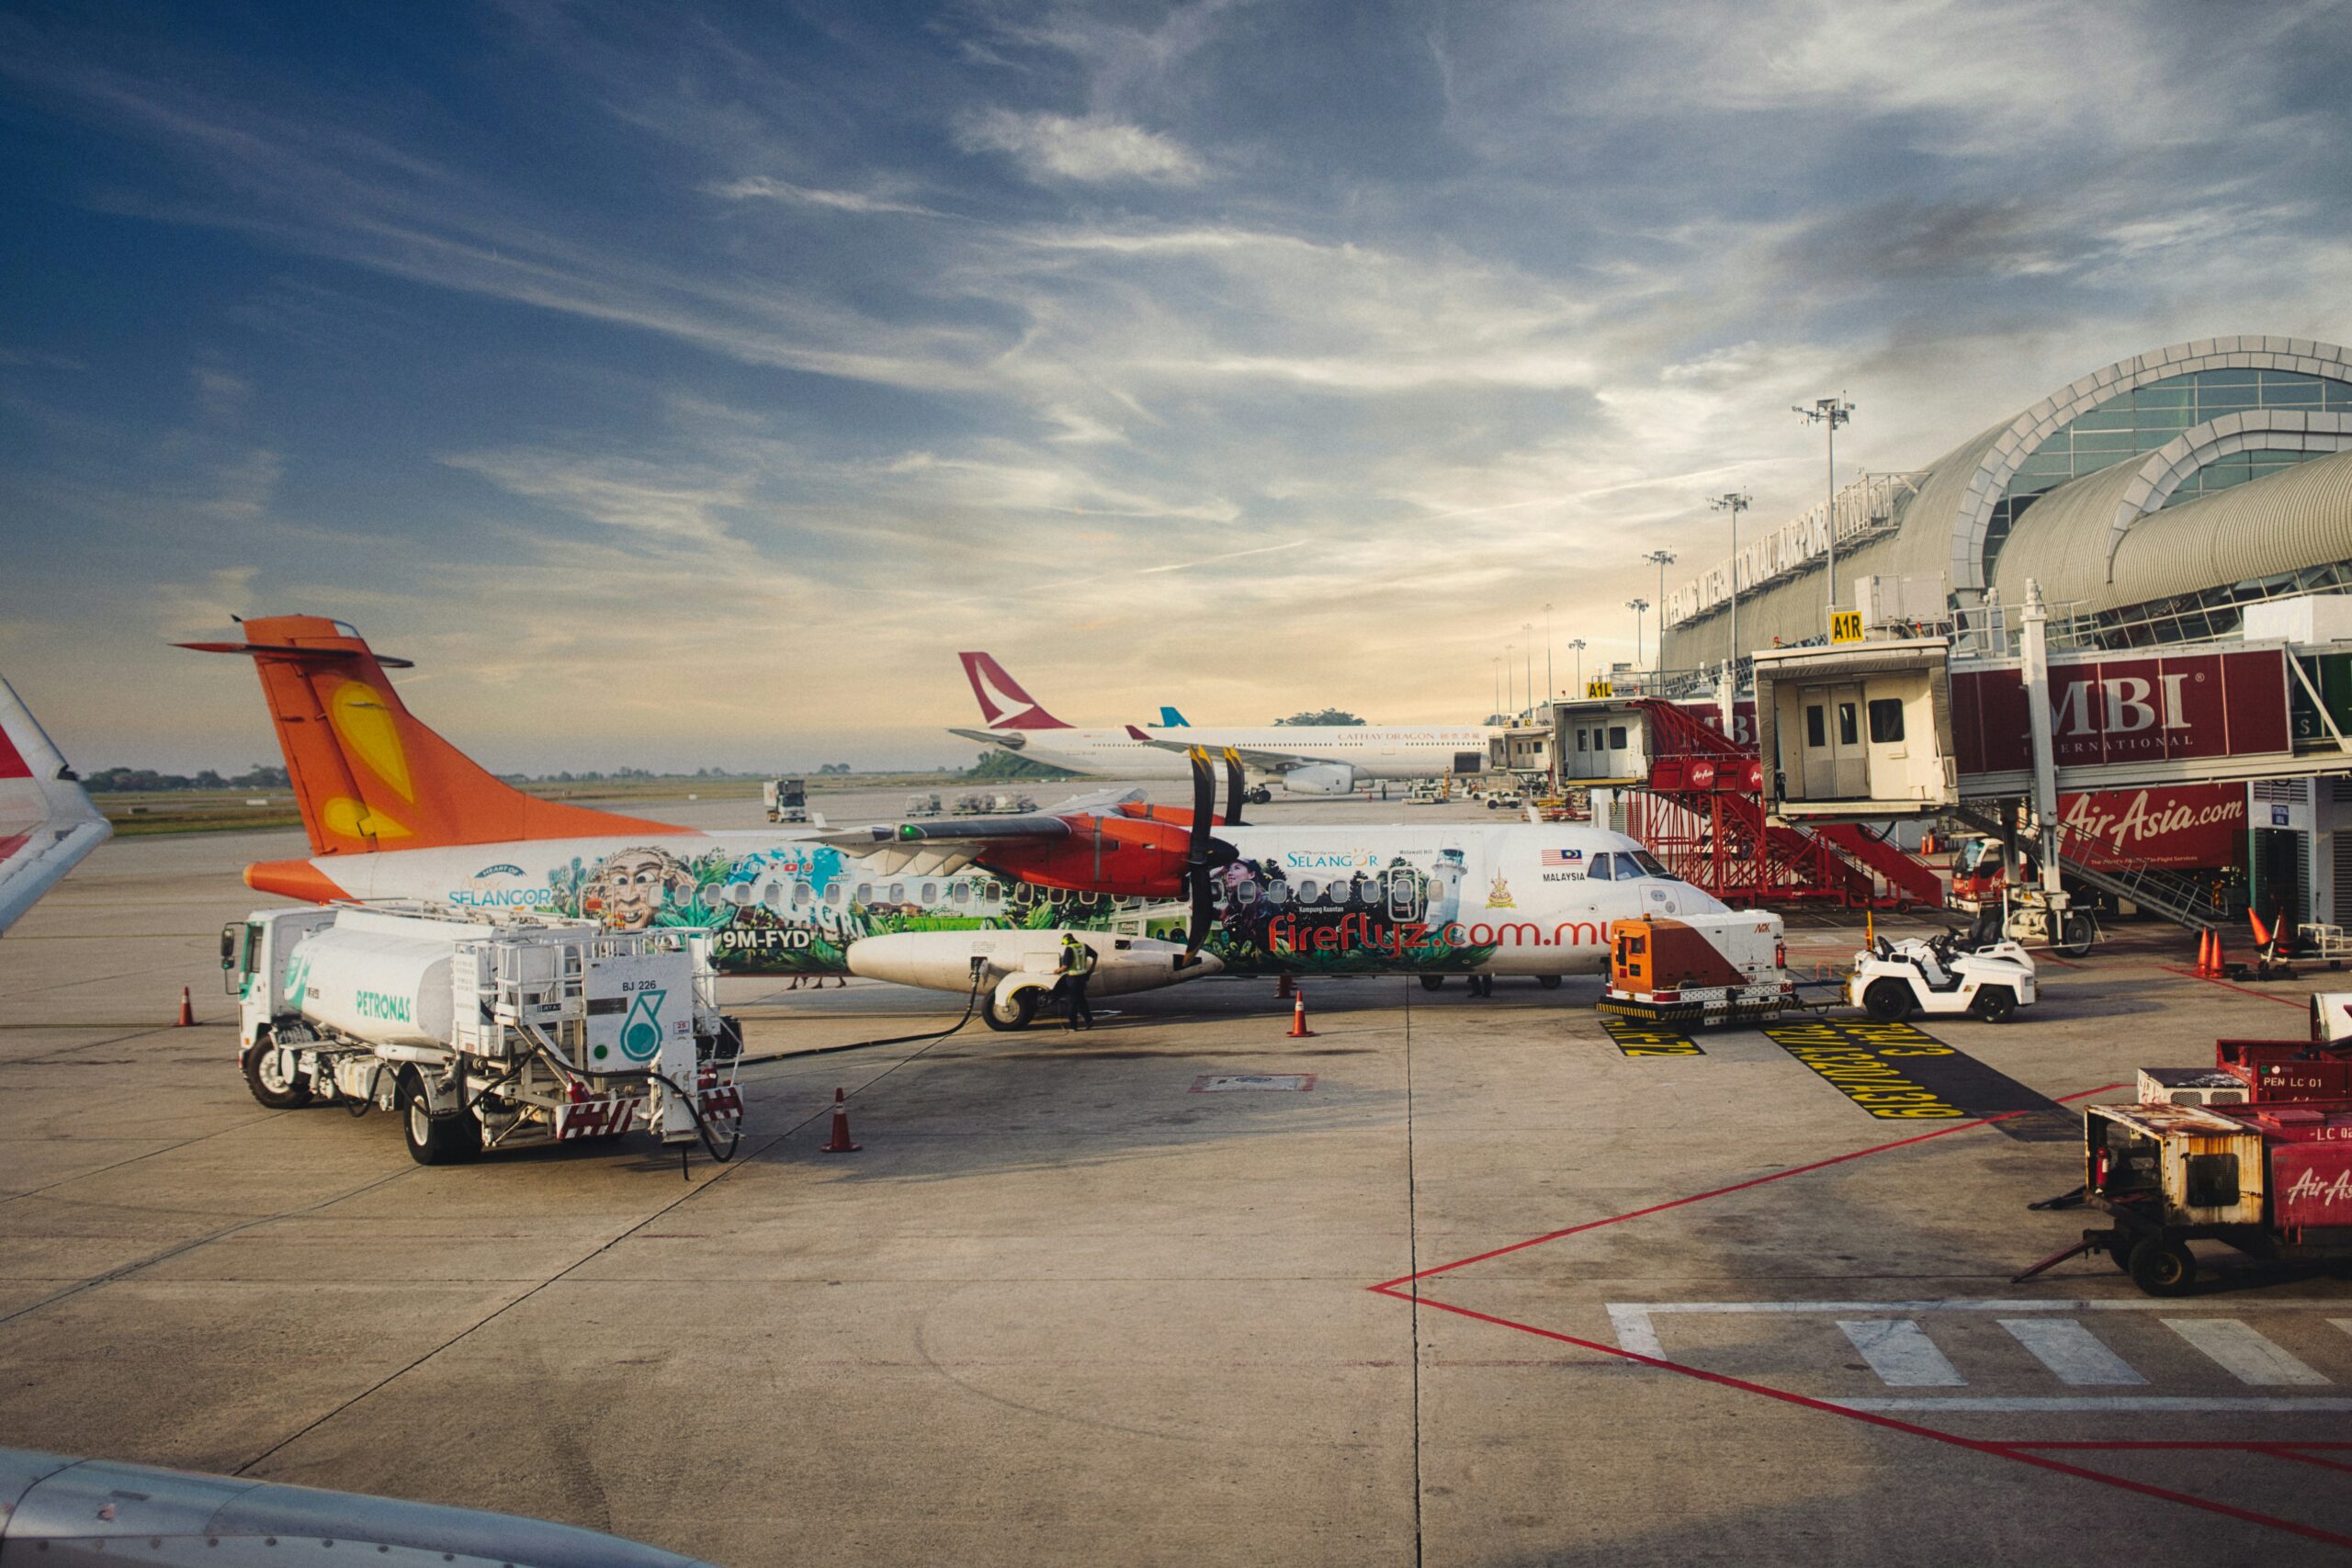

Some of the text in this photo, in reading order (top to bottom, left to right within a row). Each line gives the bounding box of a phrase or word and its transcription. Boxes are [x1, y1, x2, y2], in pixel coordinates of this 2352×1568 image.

[1834, 615, 1861, 640] A1R
[1589, 683, 1611, 698] A1L
[1338, 732, 1435, 740] CATHAY DRAGON
[2023, 736, 2194, 757] IERNATIONAL
[1287, 851, 1379, 868] SELANGOR
[1543, 872, 1586, 882] MALAYSIA
[448, 888, 551, 907] SELANGOR
[1298, 906, 1323, 914] Kampung
[722, 930, 810, 949] 9M-FYD
[622, 980, 657, 992] BJ 226
[356, 989, 411, 1023] PETRONAS
[2264, 1077, 2322, 1088] PEN LC 01
